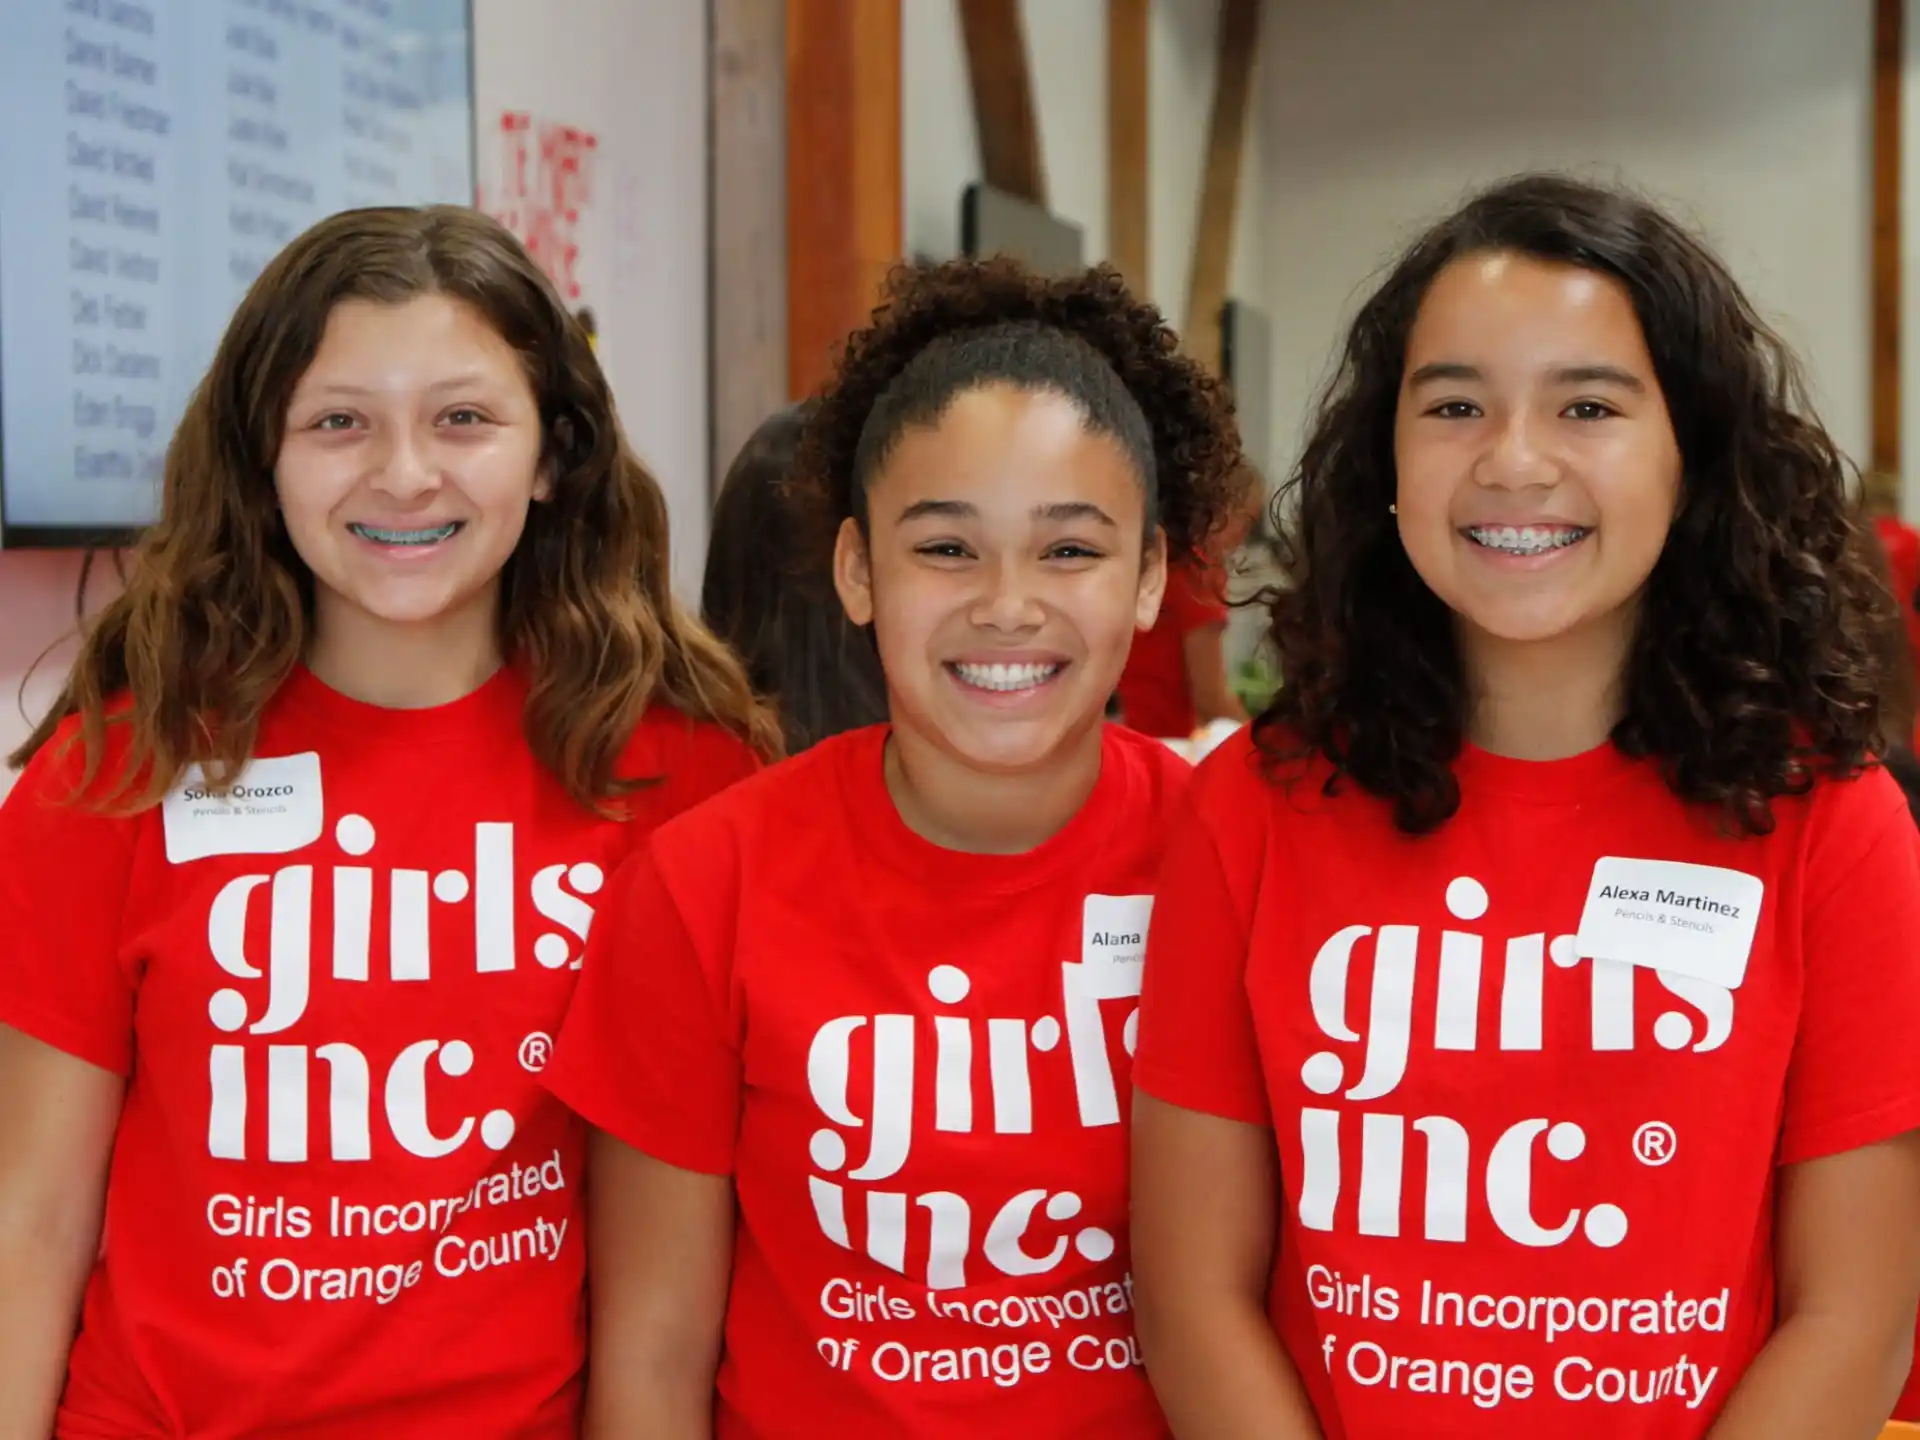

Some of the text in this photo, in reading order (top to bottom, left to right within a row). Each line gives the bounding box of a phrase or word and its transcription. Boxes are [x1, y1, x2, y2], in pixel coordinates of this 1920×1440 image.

[232, 785, 294, 799] Orozco
[208, 813, 604, 1035] girls
[1091, 931, 1141, 947] Alana
[1599, 885, 1741, 919] Alexa Martinez
[1614, 907, 1655, 923] Pencils
[1669, 914, 1715, 935] Stencils
[1301, 876, 1735, 1101] girls
[208, 1039, 515, 1162] inc.
[807, 960, 1141, 1181] girl
[1299, 1107, 1629, 1249] inc.
[207, 1193, 312, 1238] Girls
[808, 1174, 1115, 1291] inc.
[211, 1216, 567, 1305] of Orange County
[820, 1277, 916, 1322] Girls
[1306, 1264, 1730, 1343] Girls Incorporated
[816, 1336, 860, 1372] of
[871, 1340, 1051, 1387] Orange
[1347, 1340, 1534, 1409] Orange
[1553, 1353, 1719, 1410] County
